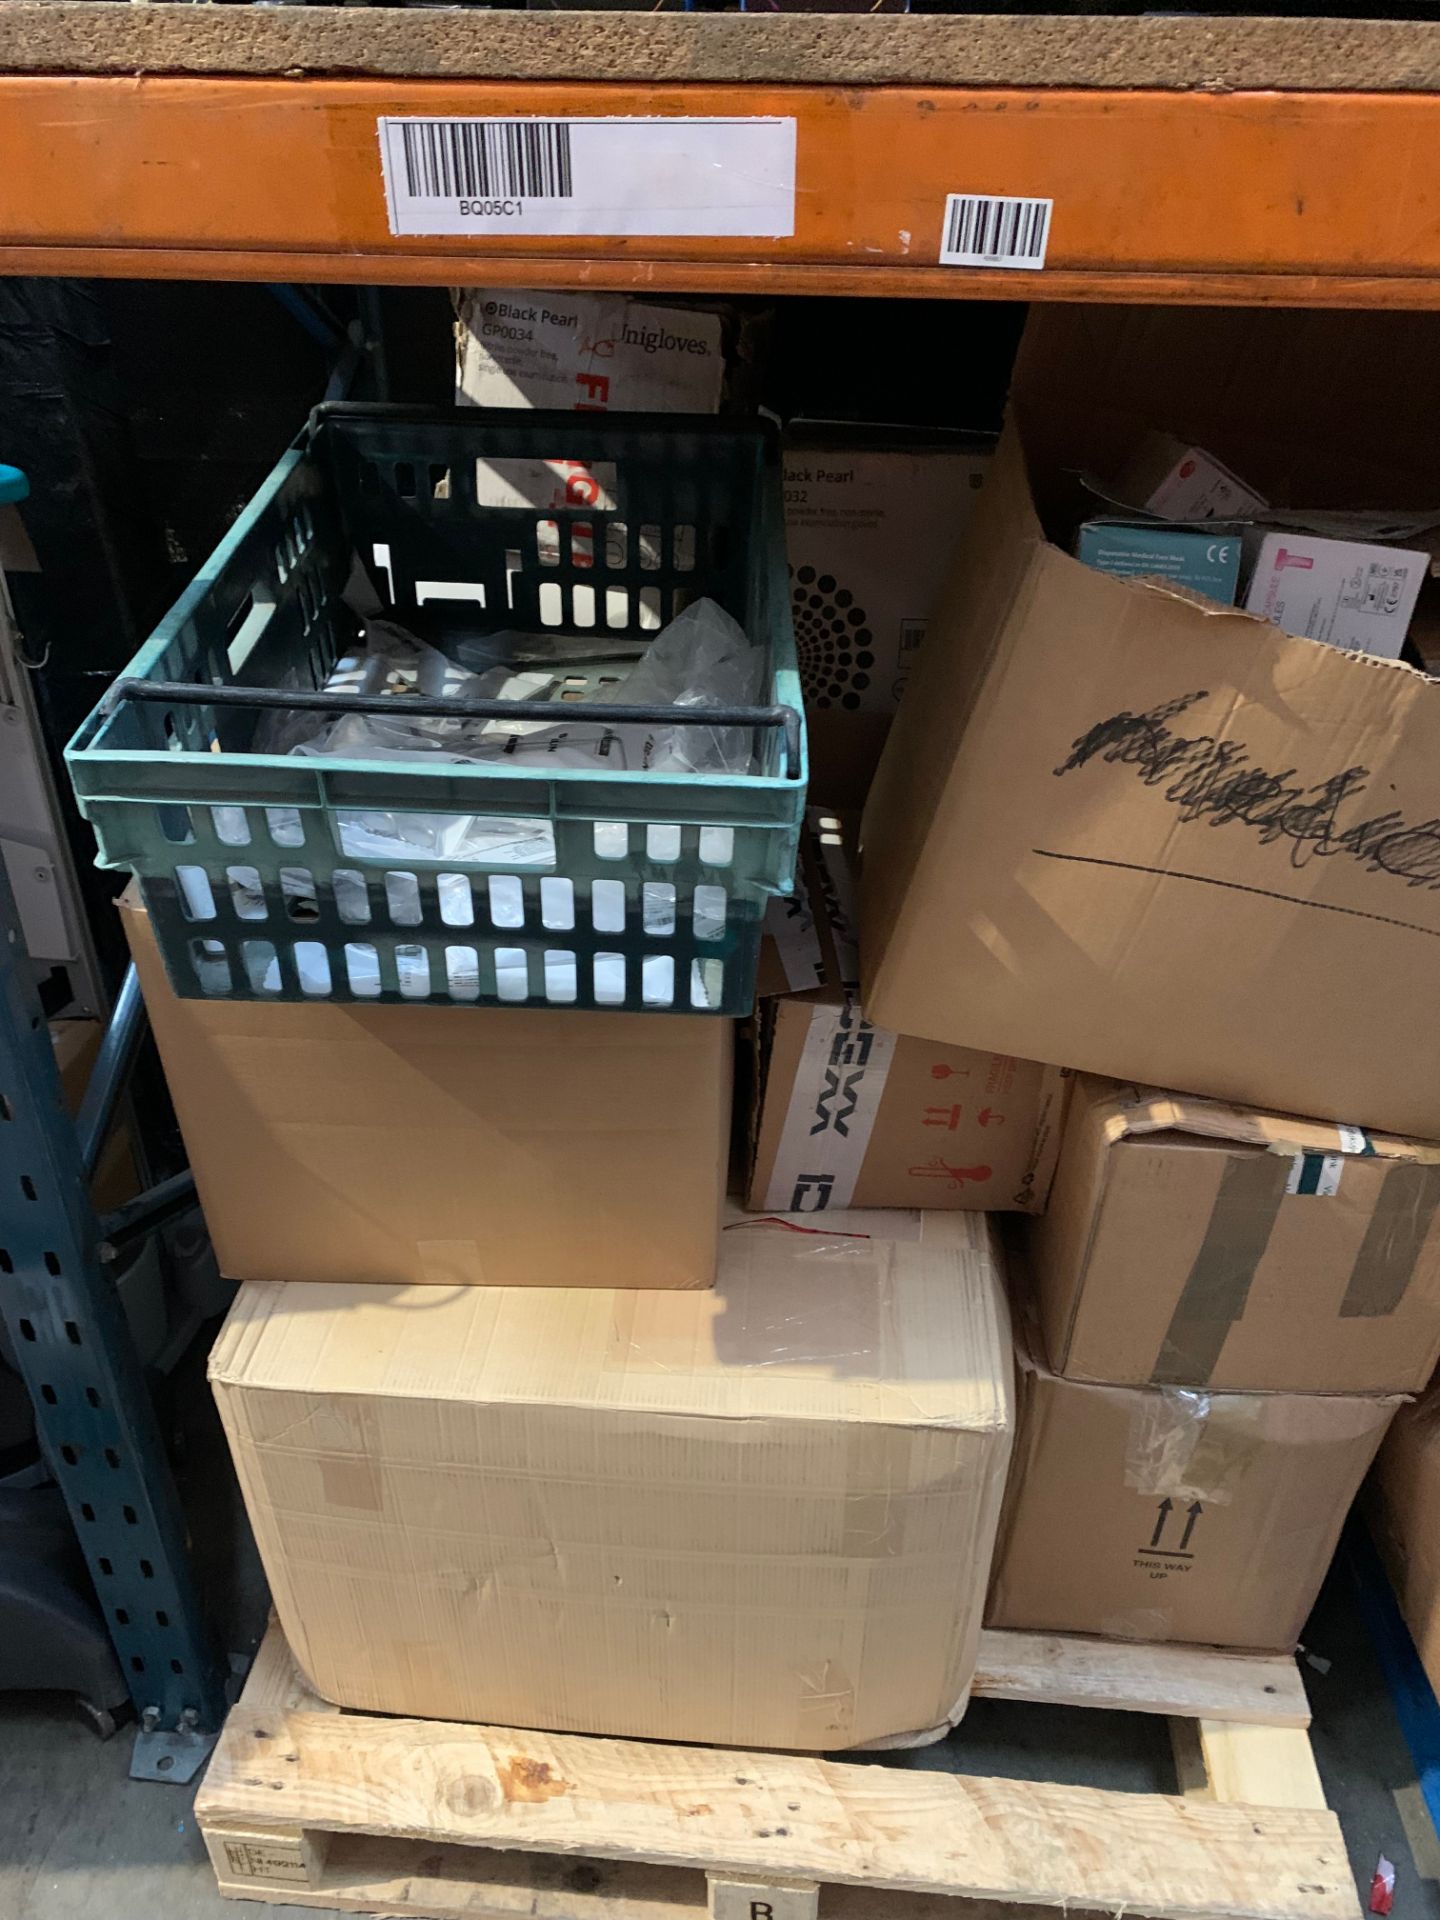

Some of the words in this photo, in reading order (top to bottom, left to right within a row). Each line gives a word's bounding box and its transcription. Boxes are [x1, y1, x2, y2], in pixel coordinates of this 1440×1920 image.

[459, 200, 523, 216] BQ05C1
[499, 303, 537, 322] Black
[541, 310, 578, 328] Pearl
[482, 322, 534, 342] GP0034
[783, 469, 812, 482] lack
[816, 470, 854, 483] Pearl
[1133, 1559, 1161, 1570] THIS
[1164, 1563, 1192, 1573] WAY
[1149, 1572, 1168, 1580] UP
